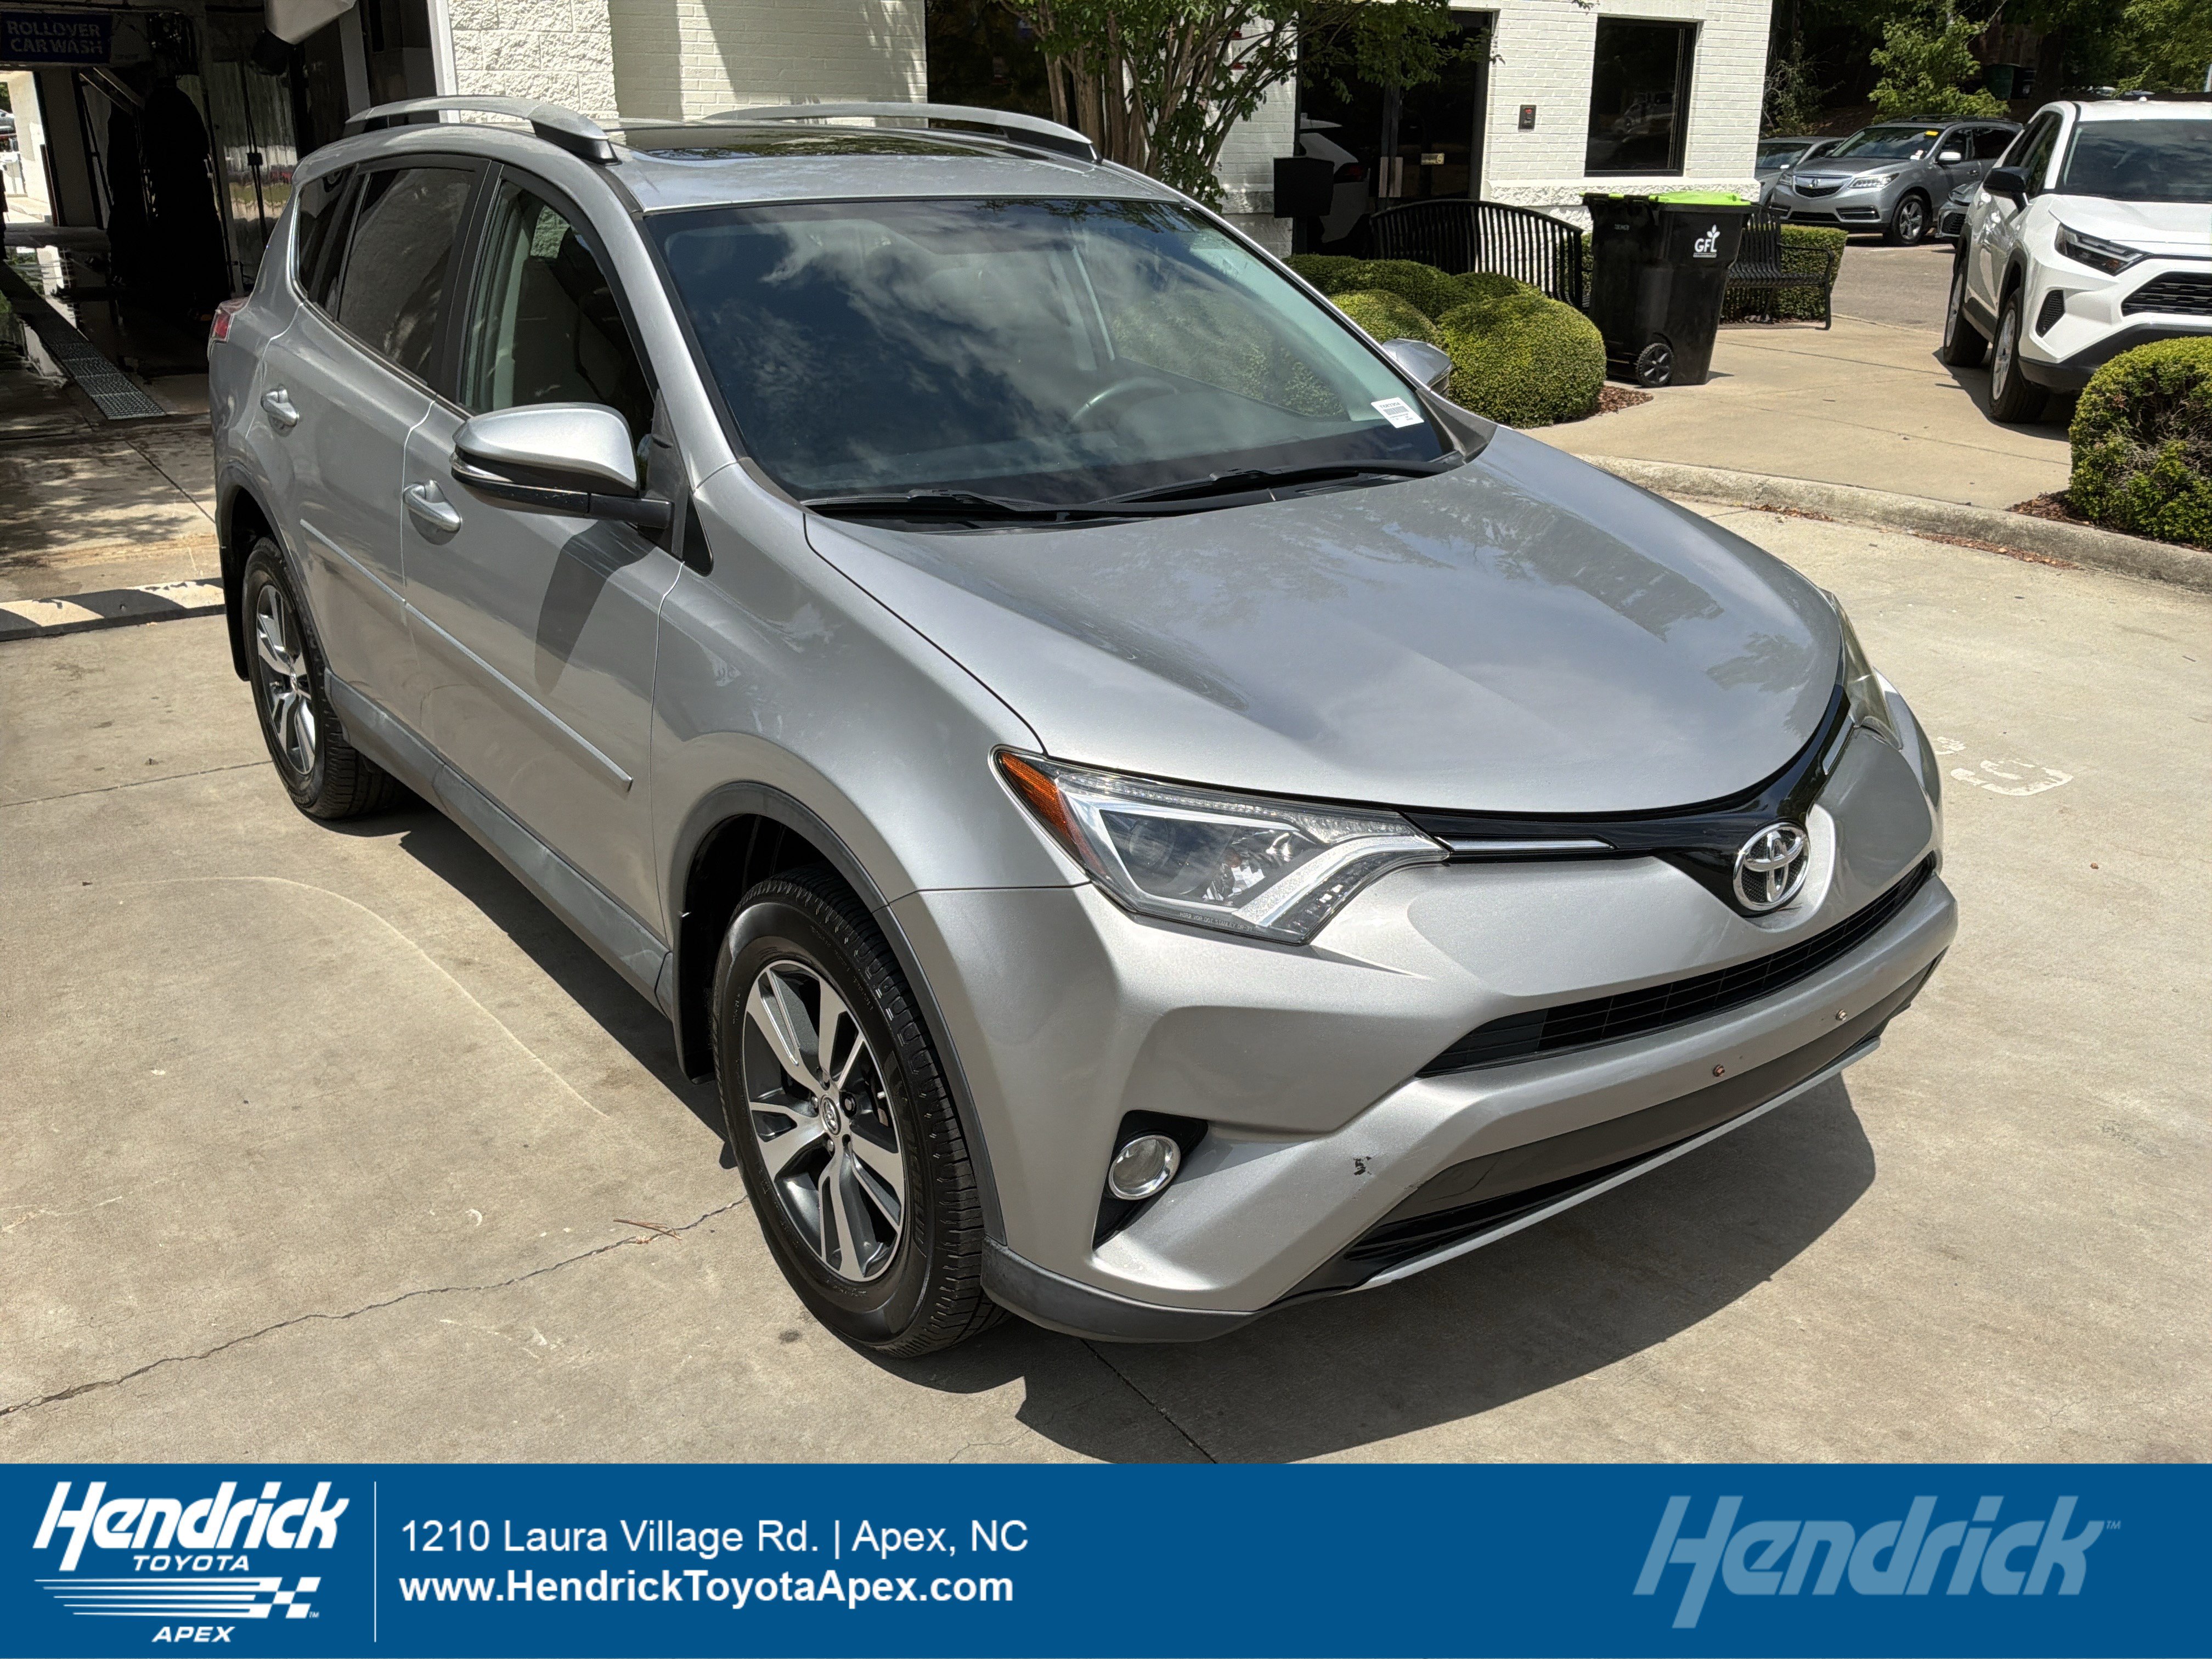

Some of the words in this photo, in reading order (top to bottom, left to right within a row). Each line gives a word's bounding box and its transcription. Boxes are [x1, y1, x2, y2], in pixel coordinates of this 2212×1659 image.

[6, 21, 100, 37] ROLLOVER
[10, 38, 50, 53] CAR
[50, 39, 103, 54] WASH
